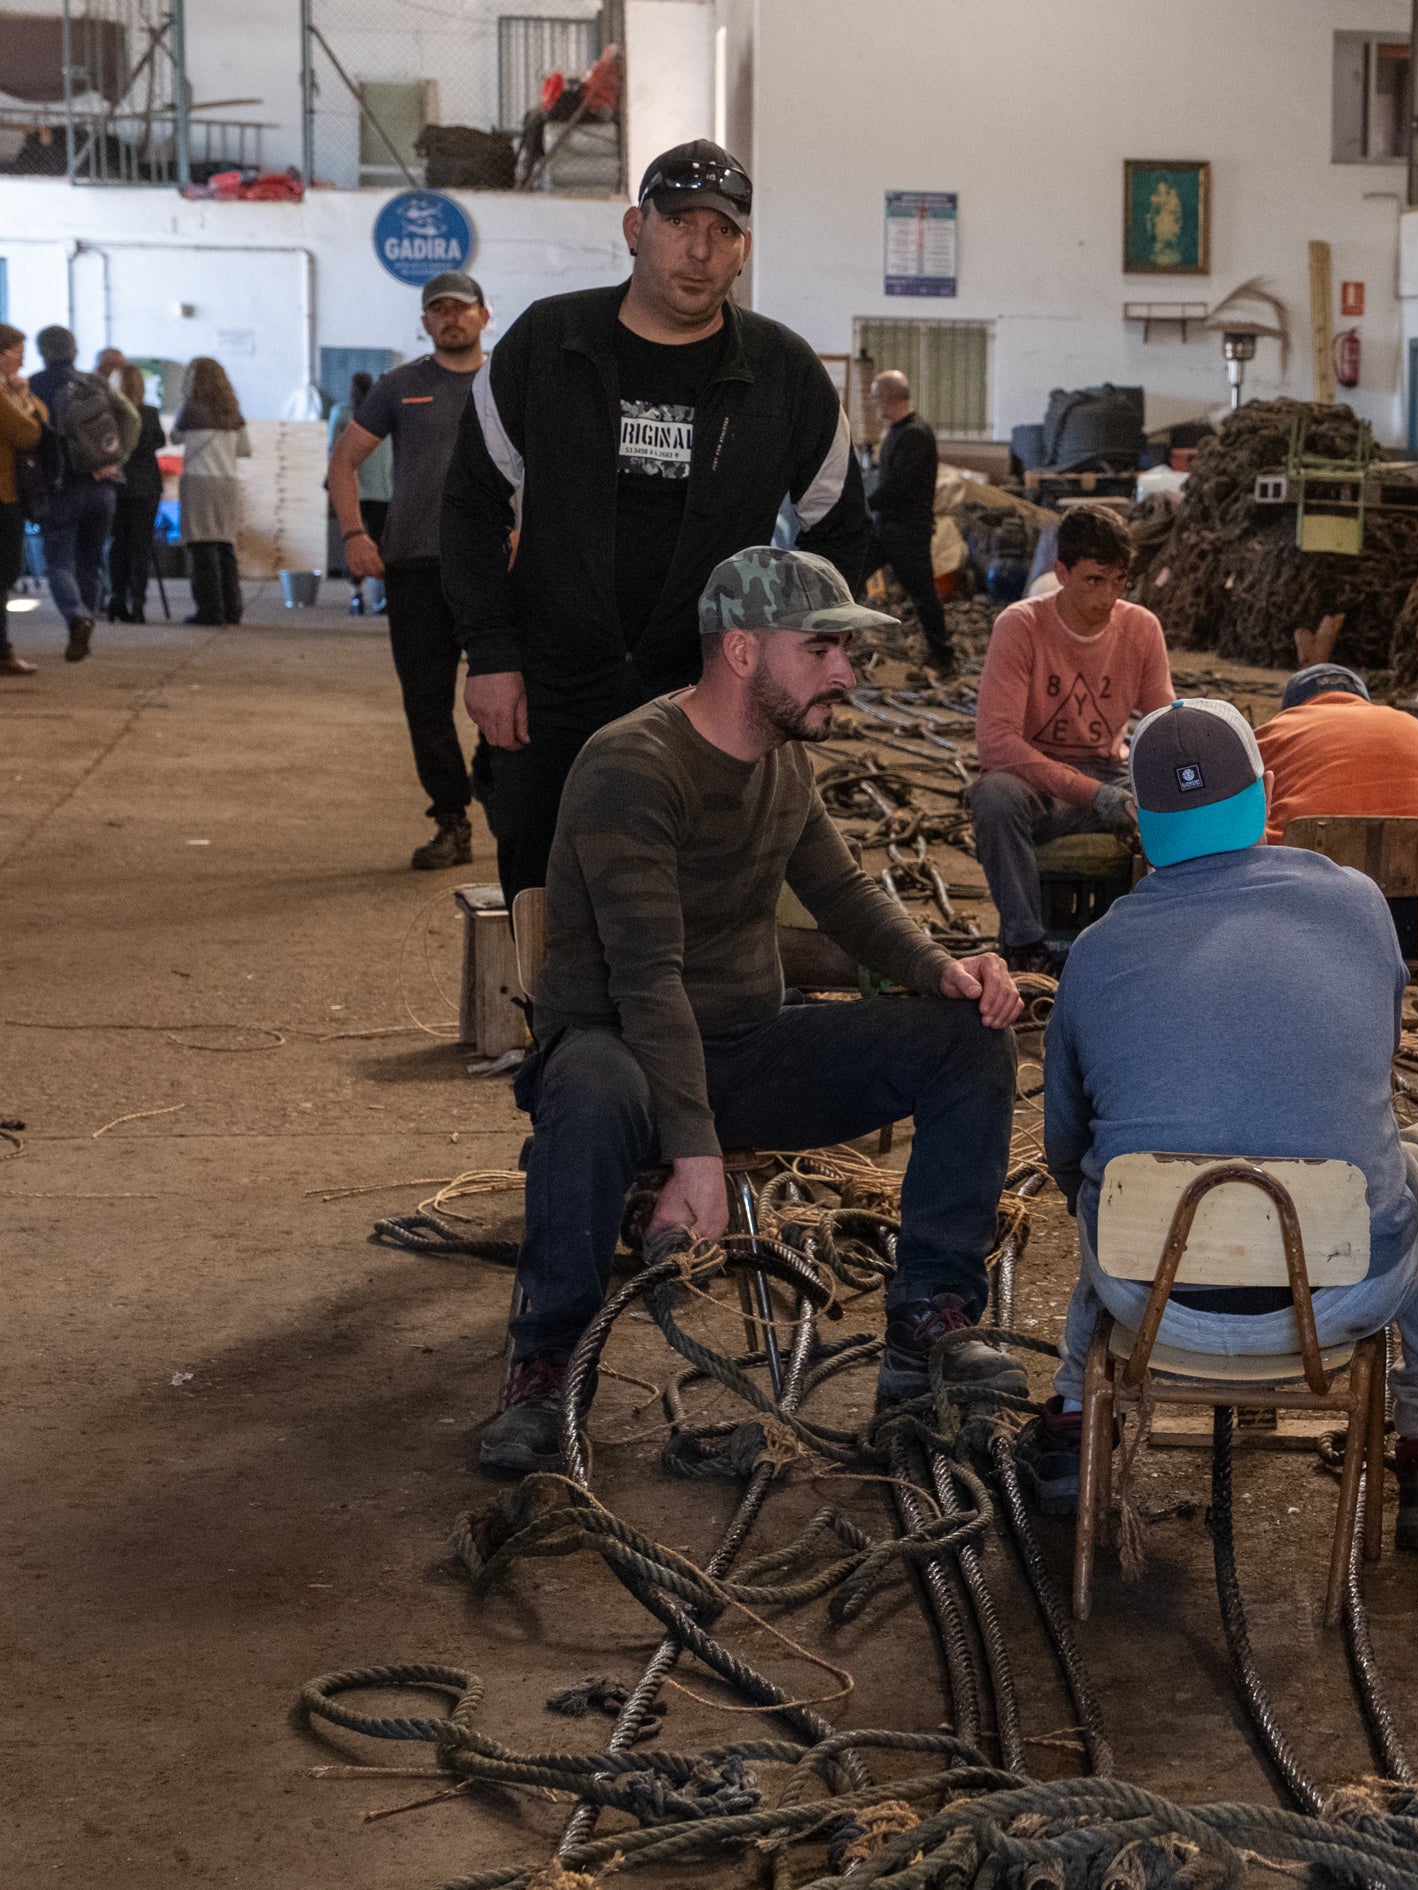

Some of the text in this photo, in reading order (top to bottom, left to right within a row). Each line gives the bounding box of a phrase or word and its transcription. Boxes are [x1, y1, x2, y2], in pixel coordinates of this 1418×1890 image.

[384, 237, 462, 261] GADIRA
[622, 422, 692, 450] RIGINAL
[1047, 674, 1111, 699] 8 2
[1074, 693, 1087, 716] Y
[1052, 719, 1101, 742] E S
